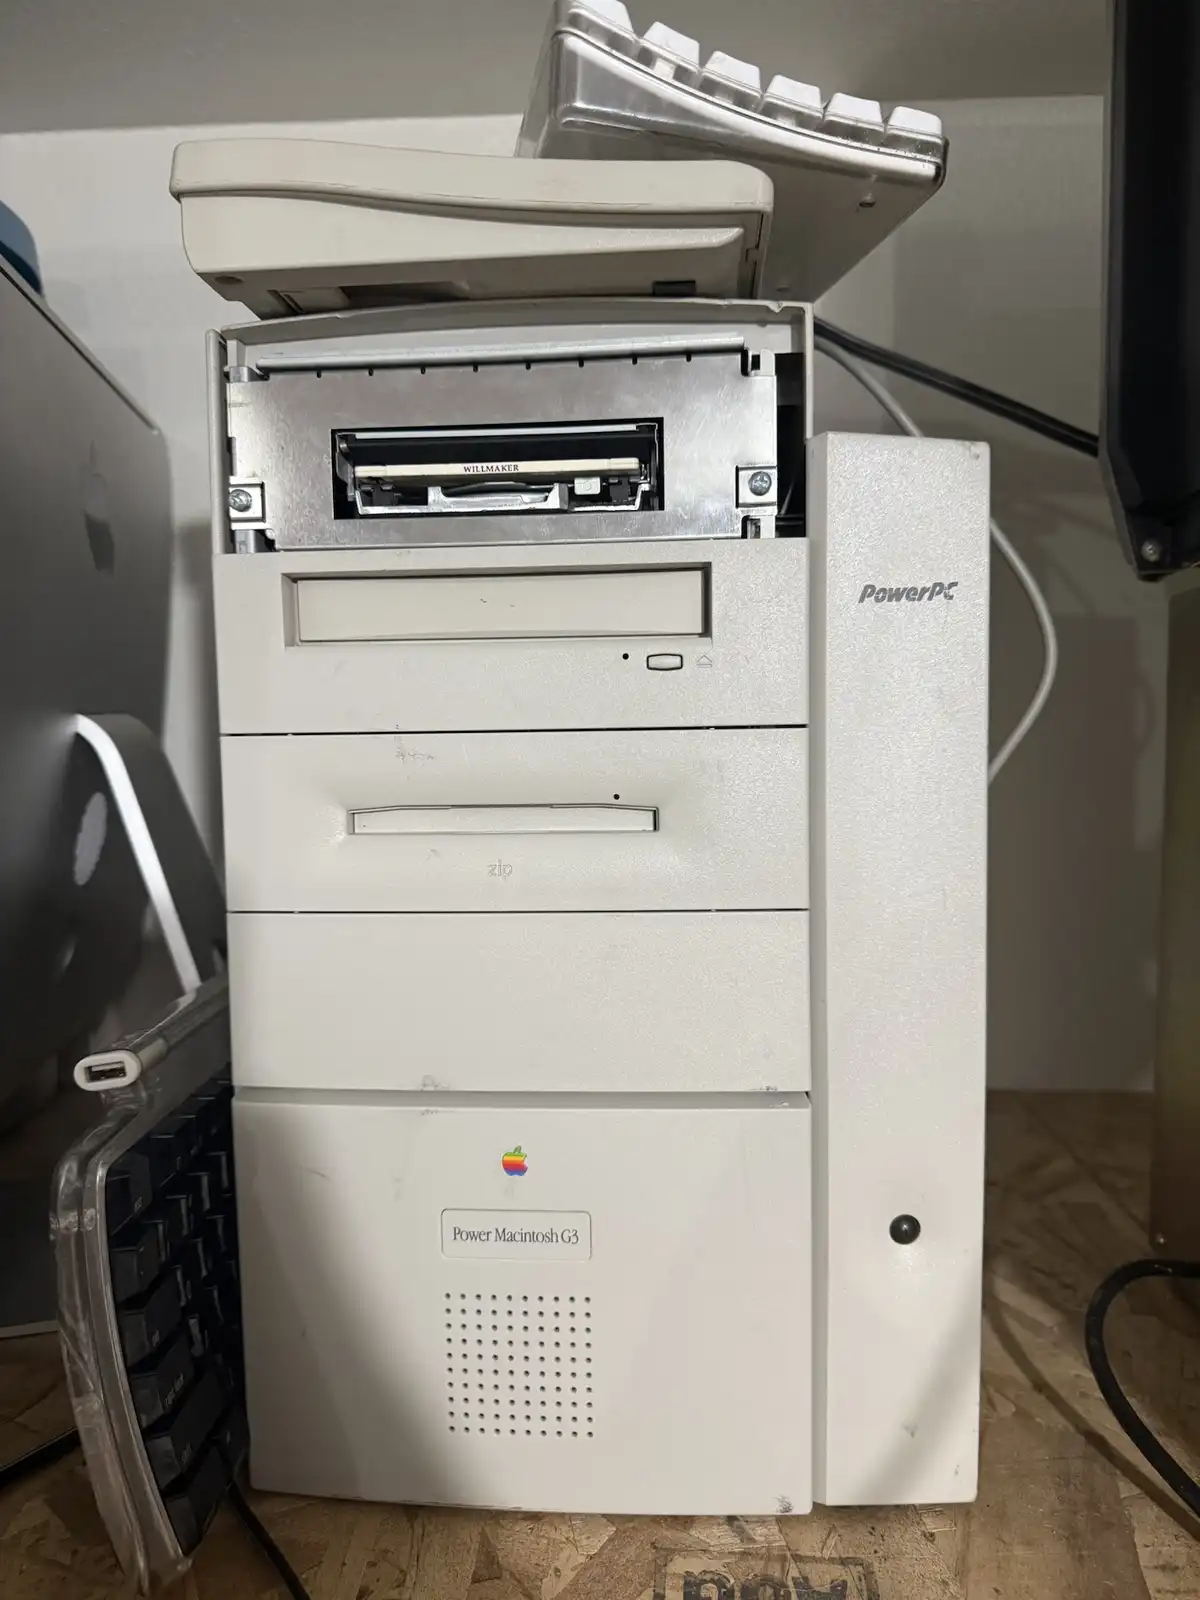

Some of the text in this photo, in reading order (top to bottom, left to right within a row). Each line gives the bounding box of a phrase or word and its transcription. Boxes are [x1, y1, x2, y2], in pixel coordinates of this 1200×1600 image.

[463, 464, 519, 473] WILLMAKER
[858, 581, 959, 603] PowerPC
[486, 859, 513, 882] zip
[453, 1226, 579, 1245] Power Macintosh G3
